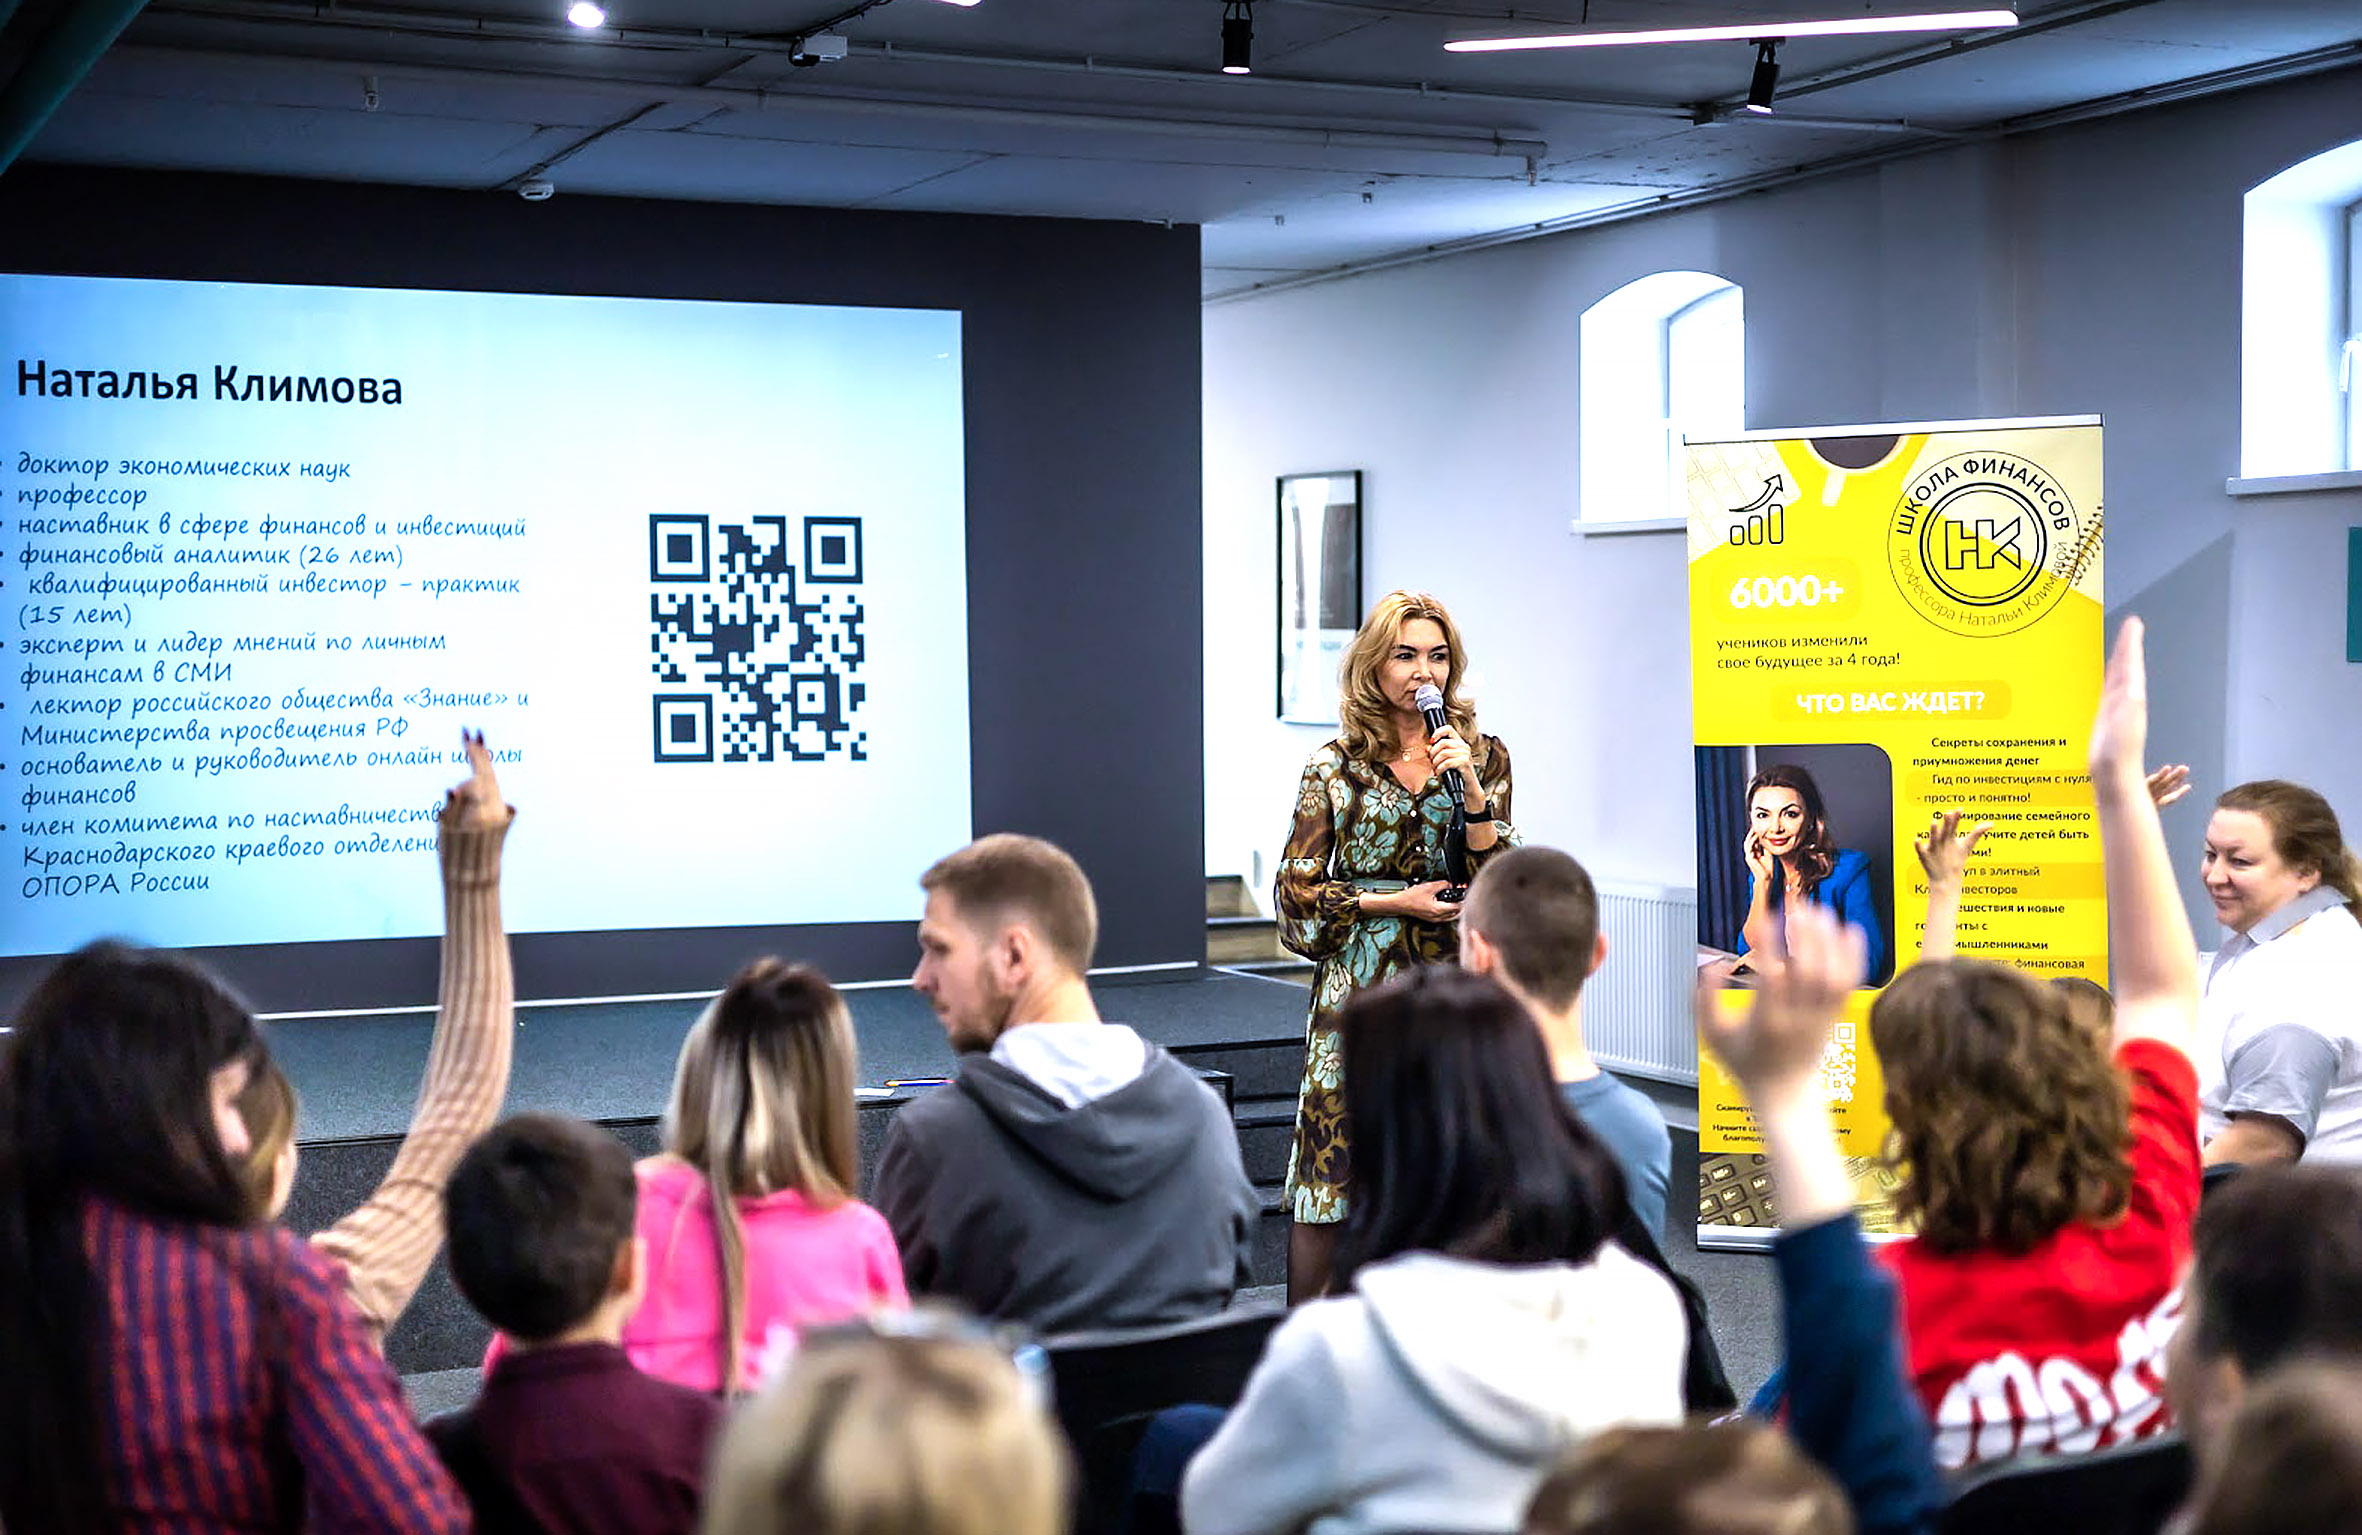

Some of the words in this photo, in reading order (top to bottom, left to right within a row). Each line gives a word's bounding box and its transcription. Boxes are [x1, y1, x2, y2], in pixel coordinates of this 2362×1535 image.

[18, 360, 198, 399] Наталья
[215, 365, 402, 404] Климова
[18, 451, 108, 481] доктор
[119, 459, 290, 477] экономических
[301, 461, 350, 482] наук
[18, 482, 147, 510] профессор
[1896, 466, 1959, 535] ШКОЛА
[1963, 458, 2070, 532] ФИНАНСОВ
[19, 511, 149, 534] наставник
[159, 512, 170, 533] в
[180, 513, 248, 541] сфере
[259, 513, 366, 541] финансов
[376, 524, 386, 535] и
[397, 514, 526, 540] инвестиций
[19, 541, 163, 570] финансовый
[174, 549, 290, 564] аналитик
[299, 545, 339, 569] (26
[350, 545, 403, 569] лет)
[29, 571, 268, 600] квалифицированный
[279, 571, 387, 599] инвестор
[422, 578, 520, 599] практик
[1730, 574, 1844, 609] 6000+
[1900, 548, 1955, 621] профессора
[1959, 608, 2024, 626] Натальи
[2023, 541, 2068, 612] Климовой
[19, 604, 64, 630] (15
[73, 603, 131, 628] лет)
[20, 638, 124, 660] эксперт
[134, 639, 146, 652] и
[157, 630, 222, 659] лидер
[233, 632, 315, 651] мнений
[327, 636, 352, 650] по
[362, 635, 446, 650] личным
[1716, 637, 1787, 651] учеников
[1791, 635, 1868, 648] изменили
[20, 662, 143, 691] финансам
[153, 660, 165, 682] в
[174, 662, 232, 683] СМИ
[1717, 657, 1751, 669] свое
[1755, 655, 1822, 671] будущее
[1828, 656, 1843, 667] за
[1847, 653, 1856, 665] 4
[1862, 652, 1900, 667] года!
[30, 698, 122, 720] лектор
[132, 691, 271, 719] российского
[281, 687, 393, 712] общества
[403, 688, 508, 708] «Знание»
[518, 694, 529, 706] и
[1796, 694, 1845, 713] ЧТО
[1851, 693, 1896, 712] ВАС
[1902, 691, 1985, 714] ЖДЕТ?
[21, 719, 210, 749] Министерства
[221, 717, 366, 747] просвещения
[376, 716, 409, 738] РФ
[1931, 738, 1983, 749] Секреты
[1986, 738, 2056, 749] сохранения
[2059, 738, 2067, 747] и
[21, 751, 162, 776] основатель
[172, 757, 185, 770] и
[195, 746, 357, 777] руководитель
[367, 746, 442, 766] онлайн
[451, 749, 522, 764] шолы
[1913, 757, 2002, 768] приумножения
[2005, 756, 2040, 768] денег
[1932, 775, 1953, 786] Гид
[1956, 776, 1970, 785] по
[1973, 775, 2051, 786] инвестициям
[2055, 776, 2061, 784] с
[2064, 775, 2093, 786] нуля
[21, 780, 136, 813] финансов
[1924, 794, 1965, 805] просто
[1969, 794, 1976, 802] и
[1979, 793, 2031, 804] понятно!
[21, 820, 74, 836] член
[85, 815, 217, 834] комитета
[228, 814, 254, 829] по
[265, 800, 442, 827] наставничеств
[1933, 811, 2022, 821] Фмирование
[2026, 810, 2090, 821] семейного
[2019, 829, 2055, 841] детей
[2059, 829, 2089, 839] быть
[24, 841, 215, 873] Краснодарского
[226, 835, 324, 865] краевого
[334, 832, 440, 854] отделени
[22, 873, 119, 898] ОПОРА
[130, 872, 209, 893] России
[1980, 868, 1986, 876] в
[1990, 866, 2040, 876] элитный
[2017, 905, 2025, 913] и
[2027, 905, 2065, 914] новые
[1982, 923, 1988, 931] с
